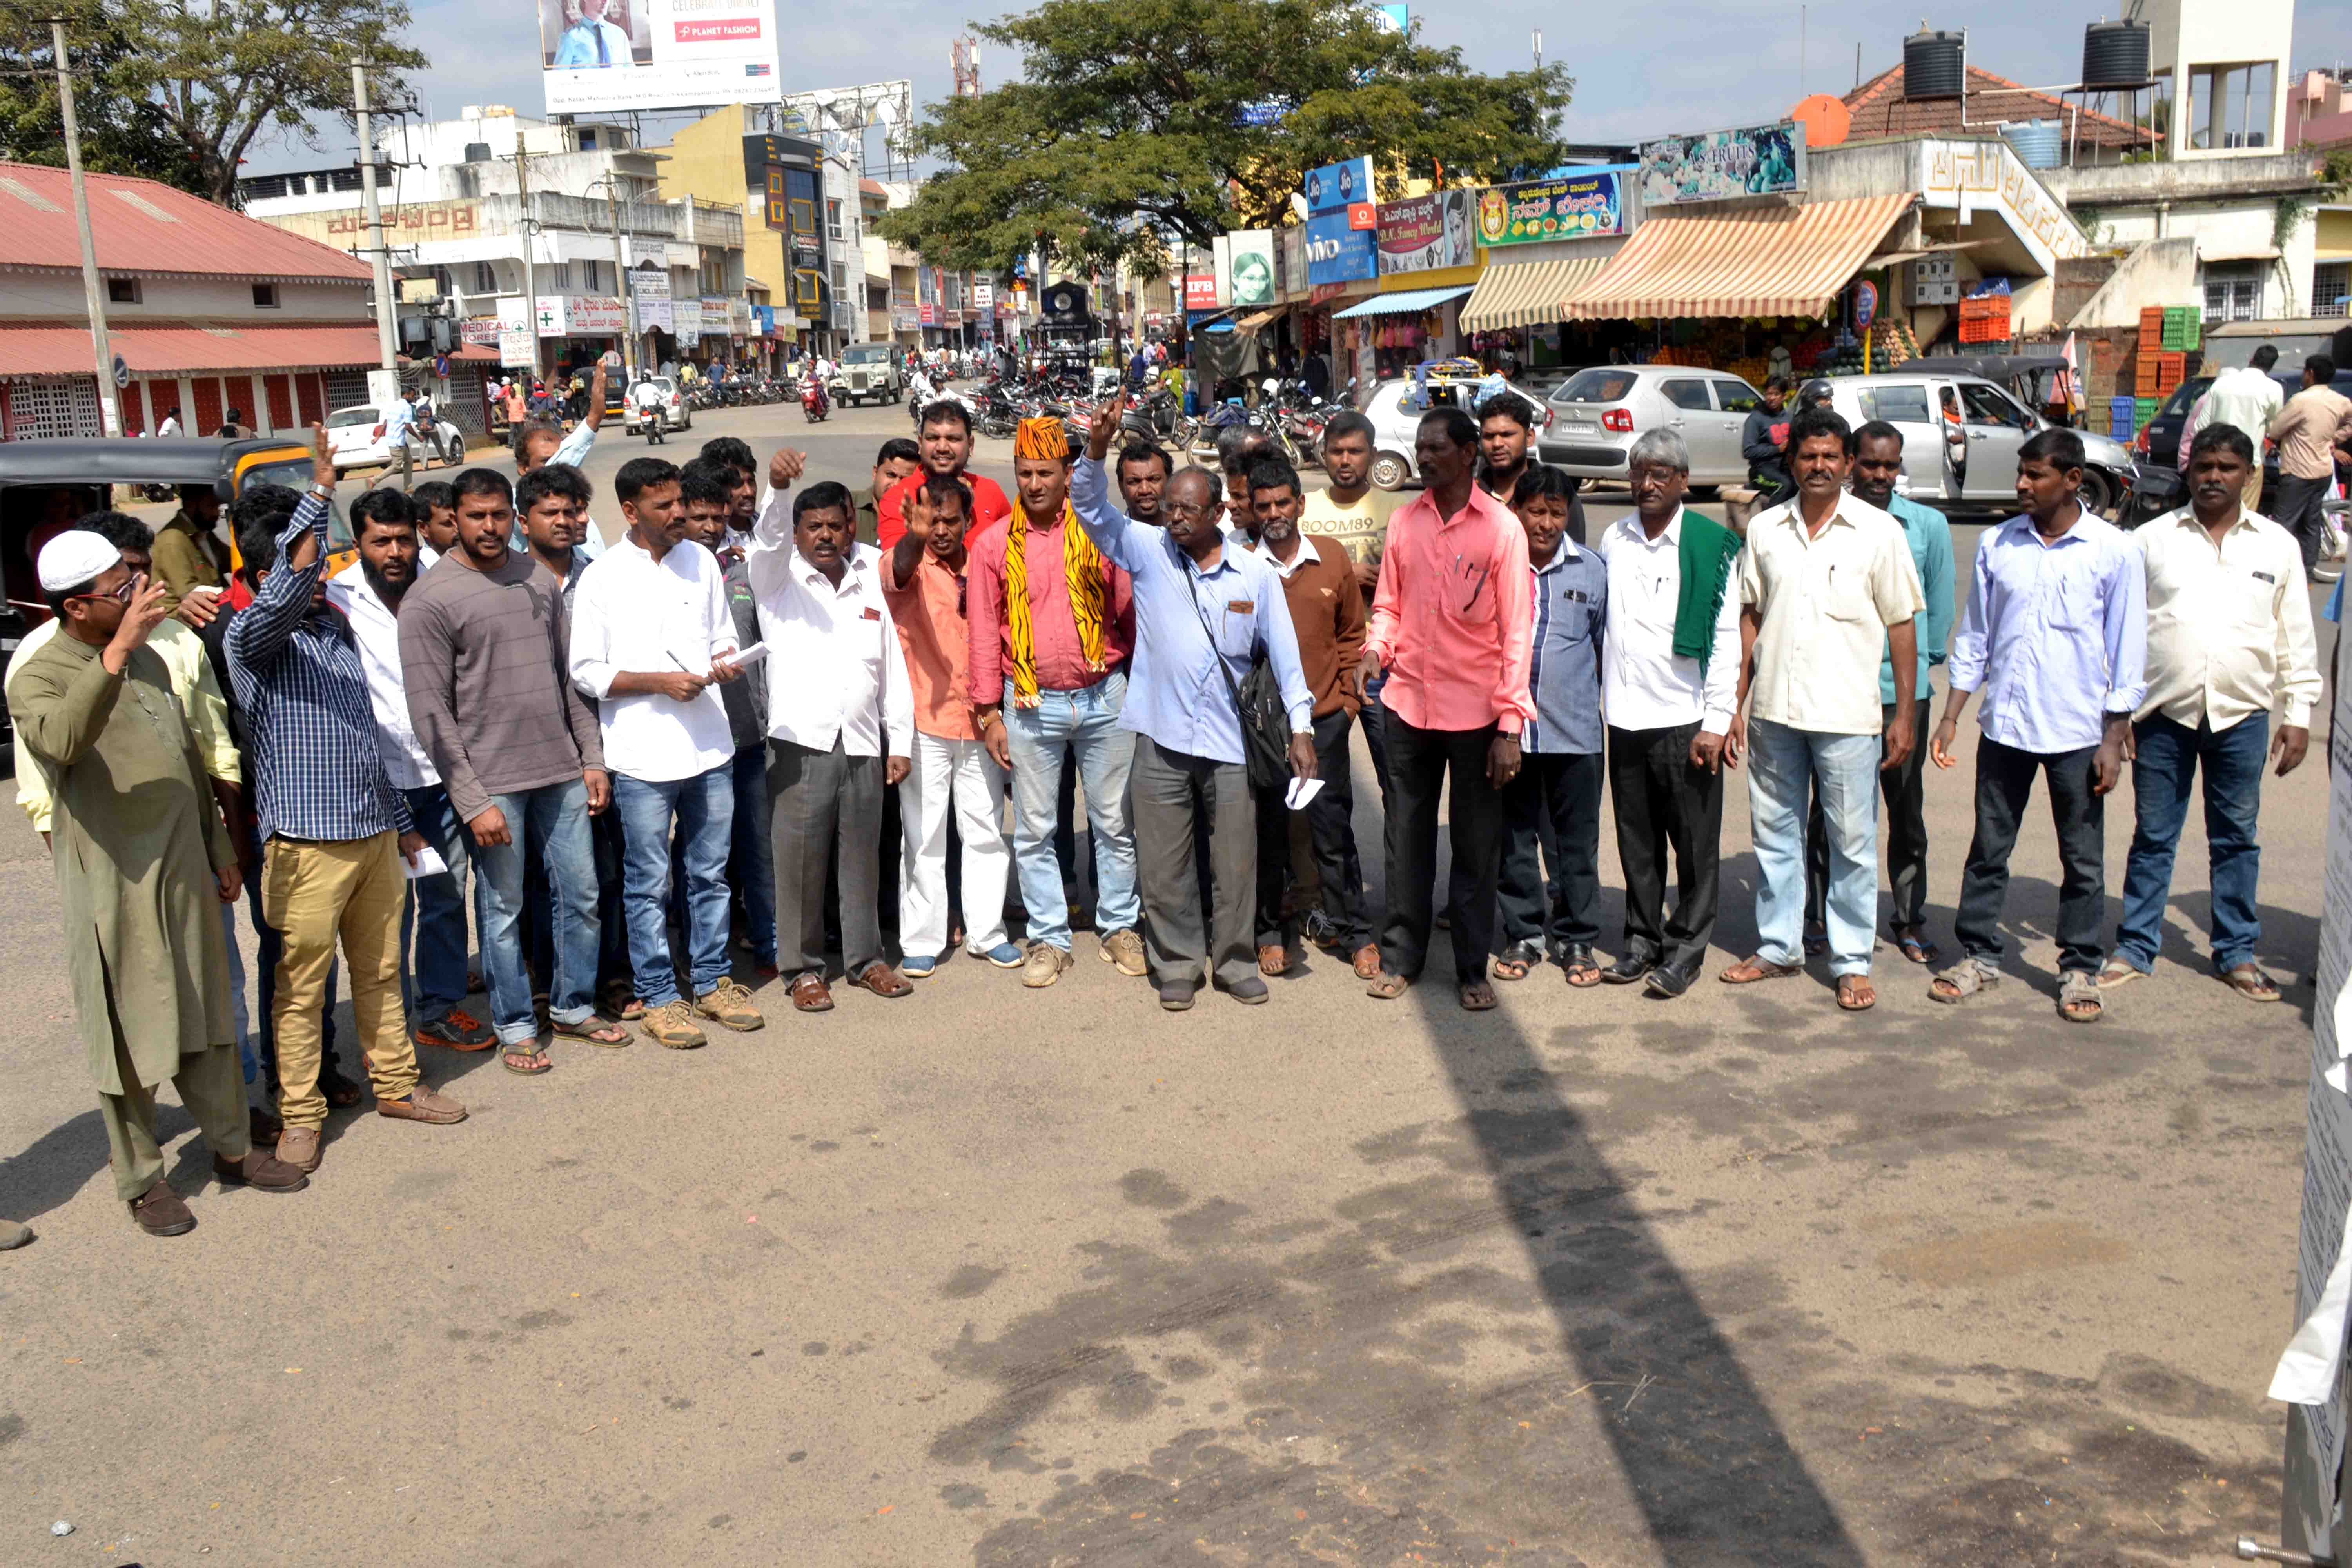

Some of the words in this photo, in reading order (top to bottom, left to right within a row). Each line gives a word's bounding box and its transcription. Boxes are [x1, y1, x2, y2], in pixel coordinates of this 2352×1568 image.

[692, 27, 722, 36] PLANET
[724, 25, 757, 35] FASHION
[1712, 144, 1756, 163] FRUITS
[1310, 180, 1321, 198] Jio
[1340, 172, 1352, 190] Jio
[1397, 226, 1418, 241] Fancy
[1419, 219, 1443, 236] World
[1305, 234, 1339, 263] vivo
[1187, 281, 1214, 292] IFB
[459, 321, 511, 333] MEDICAL
[463, 333, 498, 342] TORES
[1301, 517, 1374, 533] BOOM89
